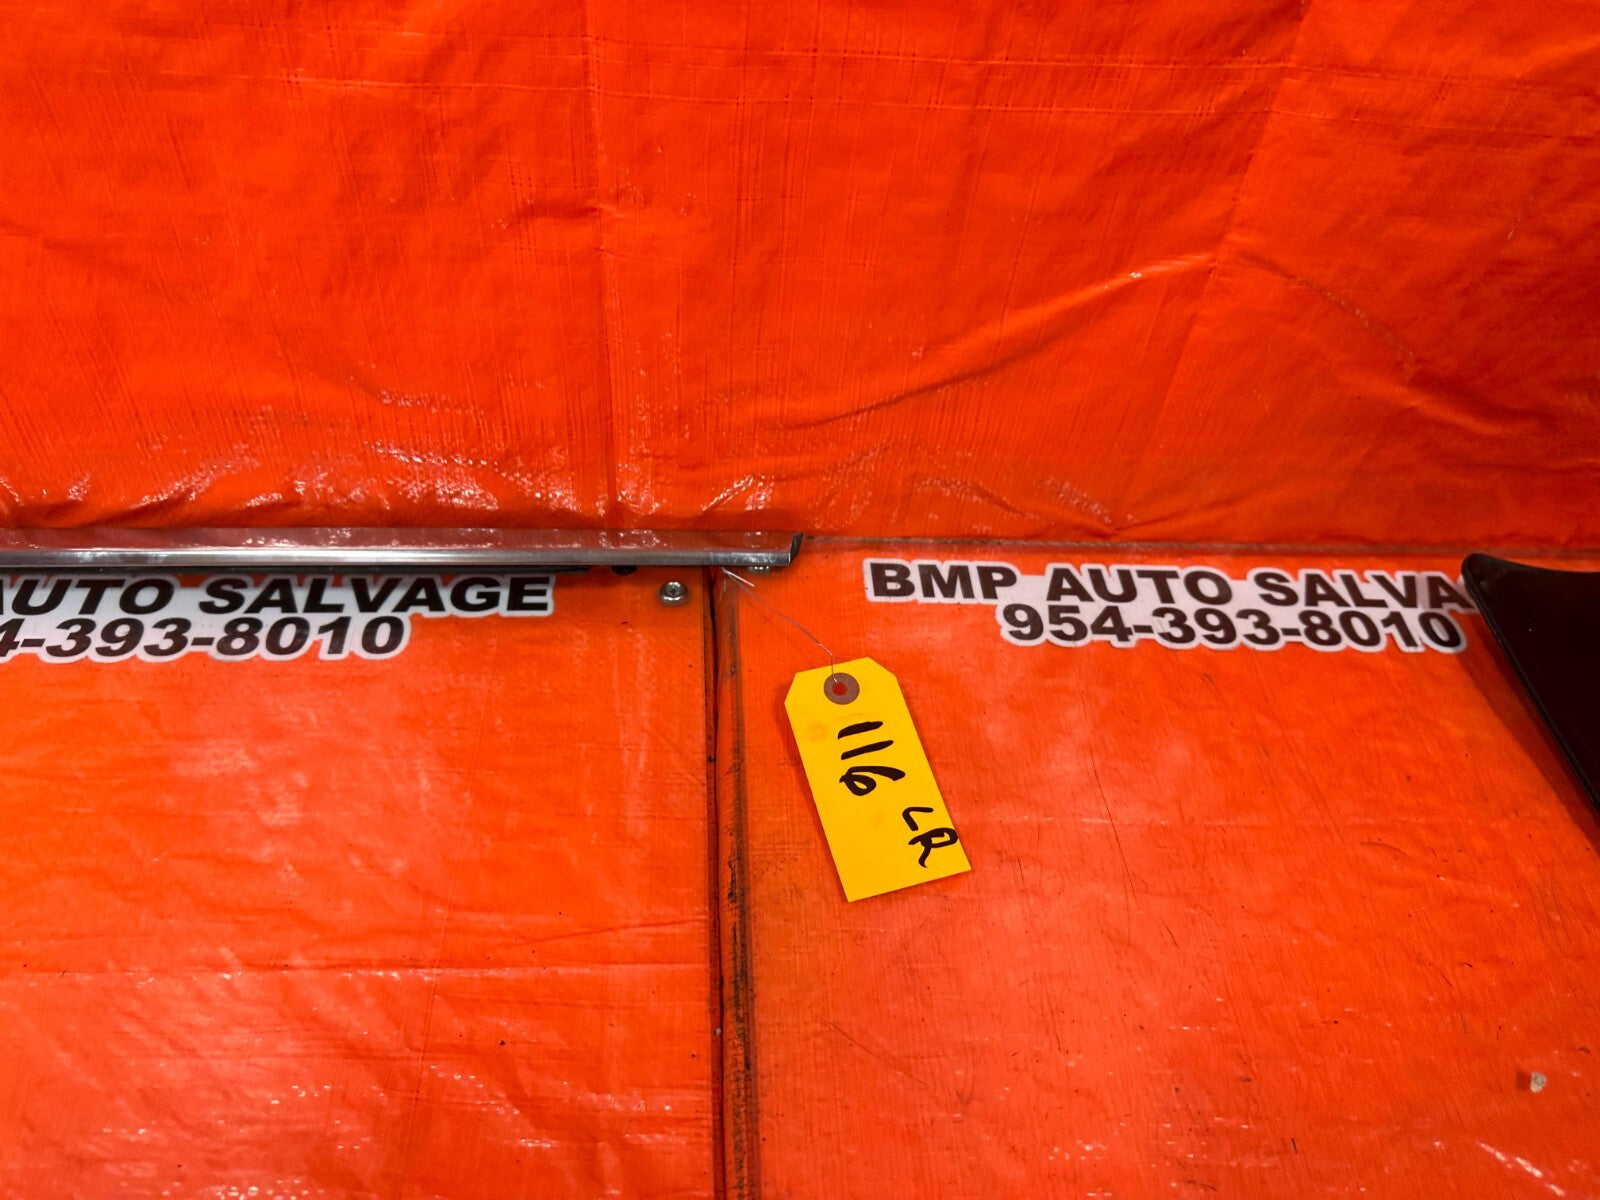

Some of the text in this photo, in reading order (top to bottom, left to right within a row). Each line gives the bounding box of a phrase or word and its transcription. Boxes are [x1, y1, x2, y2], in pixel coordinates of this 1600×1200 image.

[0, 576, 551, 616] UTO SALVAGE
[869, 562, 1018, 600] BMP
[1046, 567, 1233, 605] AUTO
[1002, 603, 1462, 649] 954-393-8010
[837, 720, 906, 797] 116
